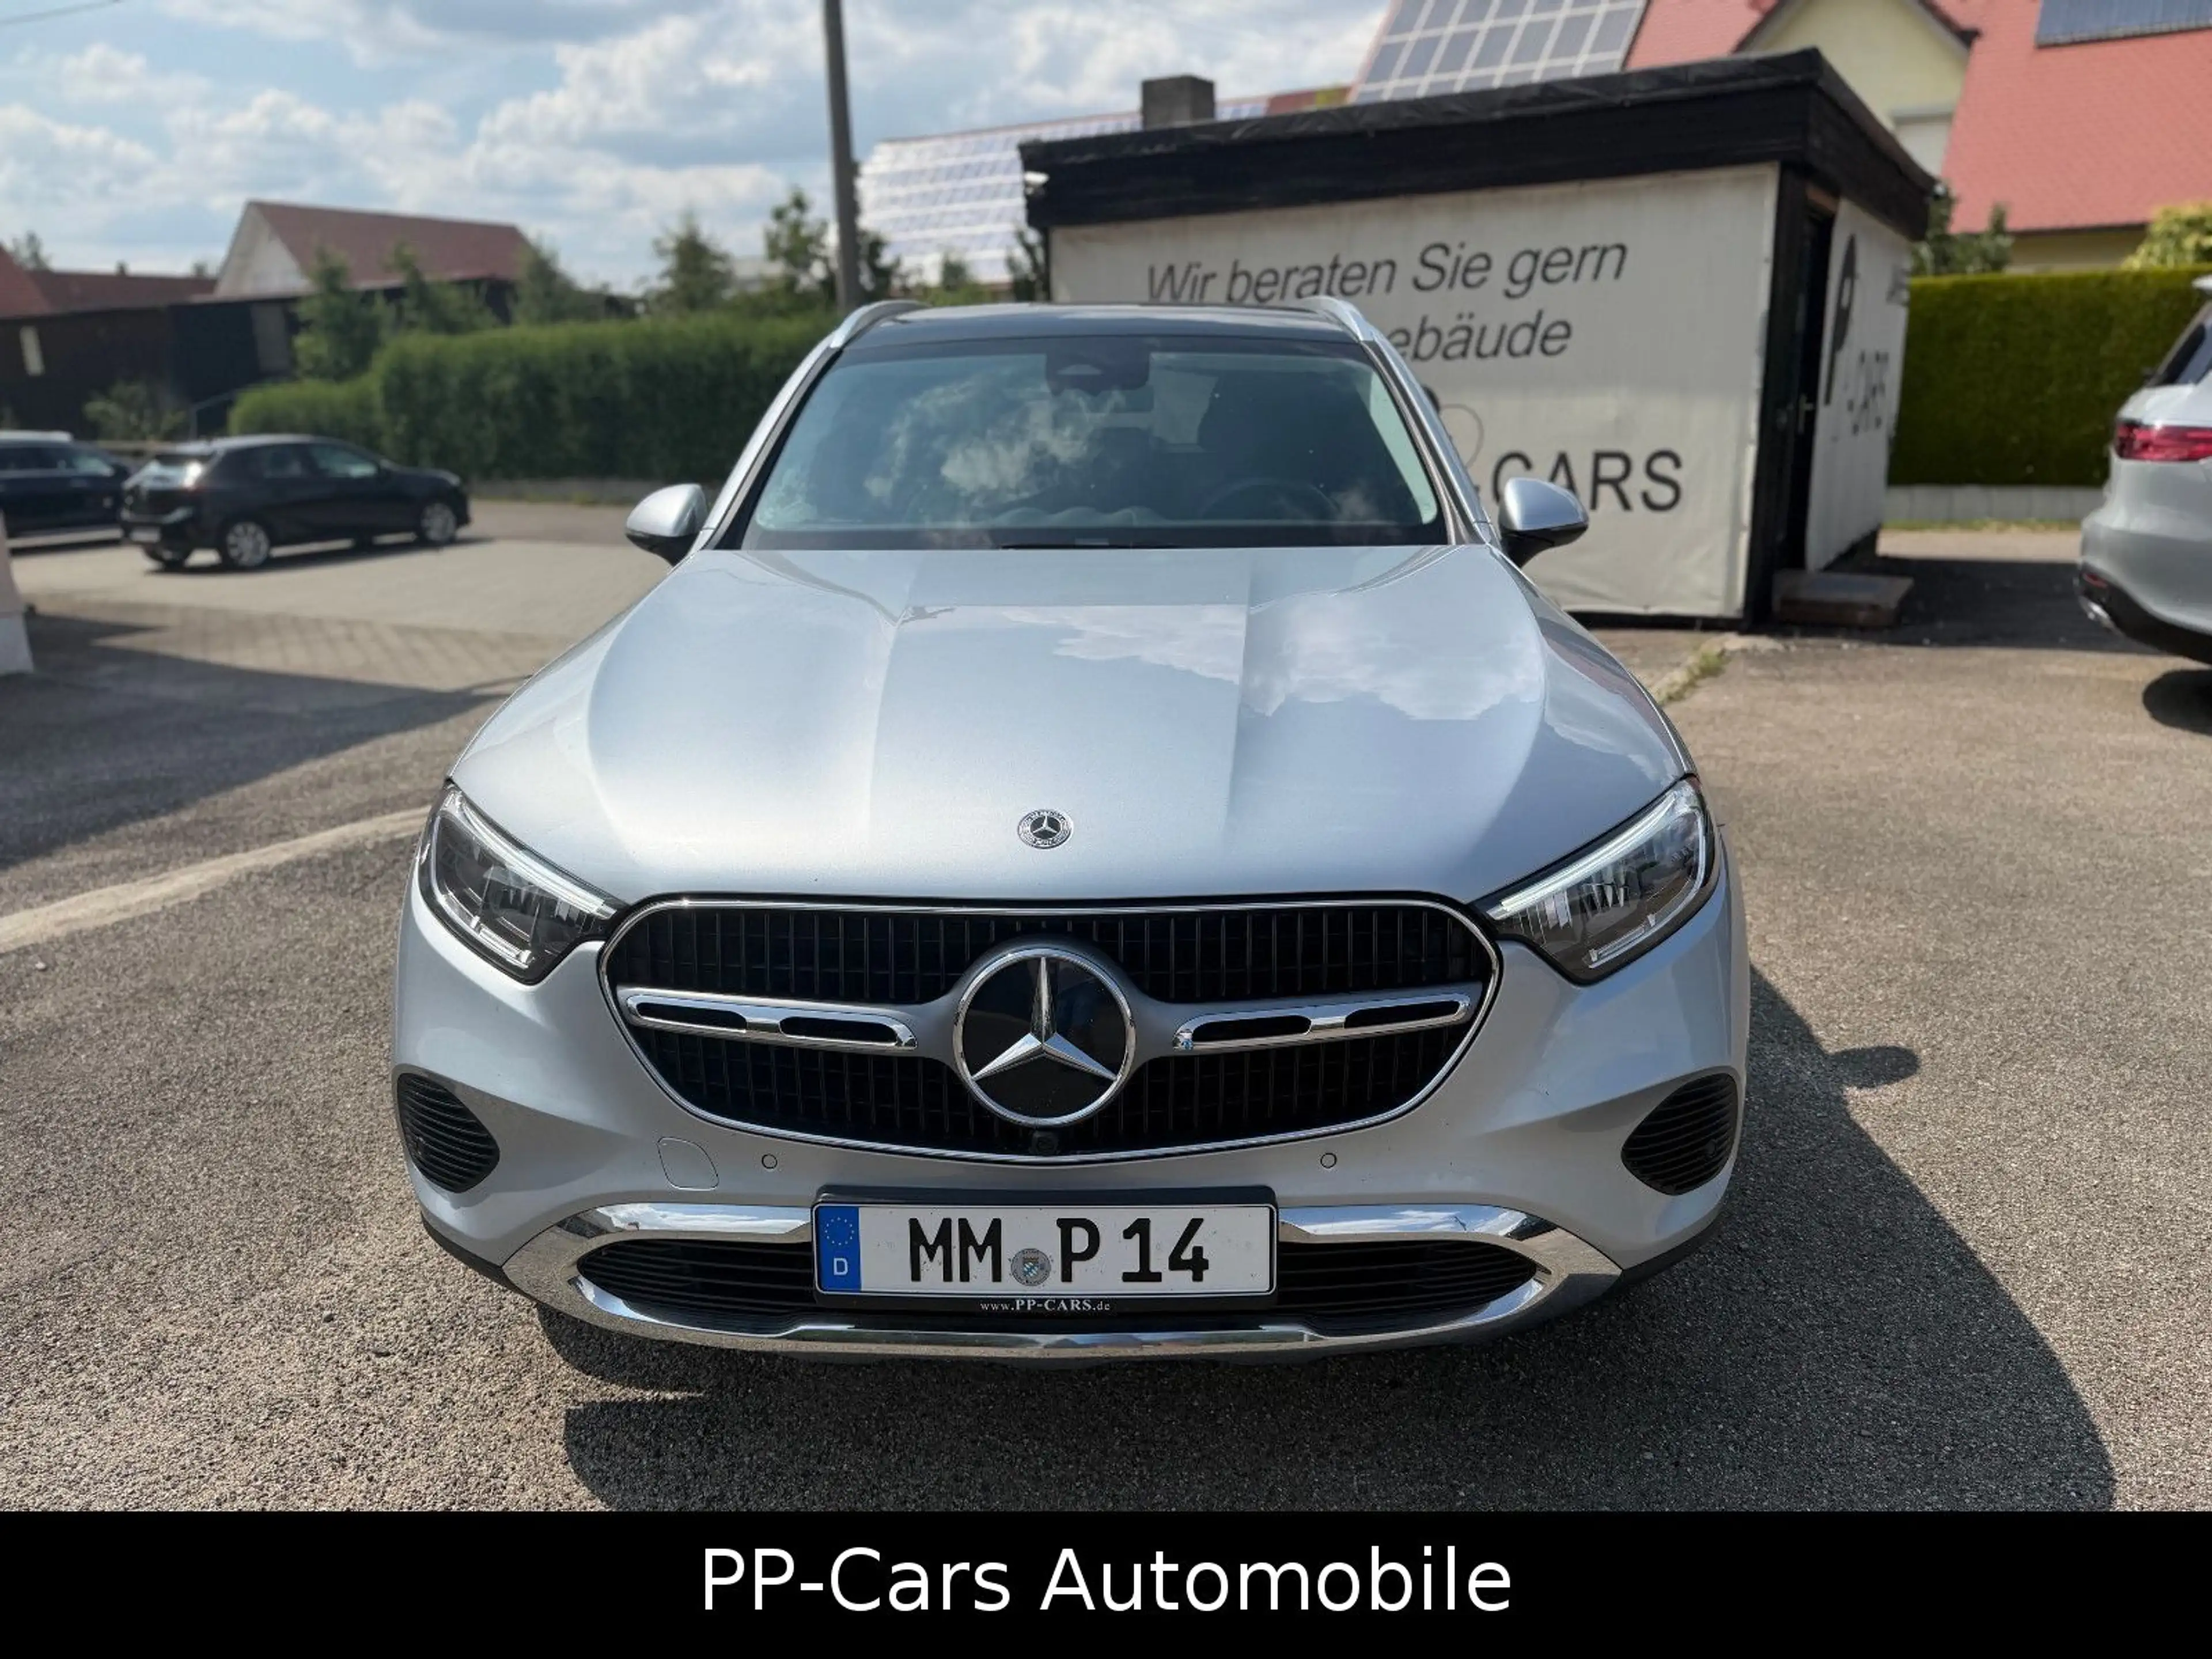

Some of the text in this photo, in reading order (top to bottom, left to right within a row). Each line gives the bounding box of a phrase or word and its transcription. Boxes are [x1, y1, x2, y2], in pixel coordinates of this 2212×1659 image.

[1147, 229, 1627, 304] Wir beraten Sie gern
[1387, 309, 1572, 362] ebäude
[834, 1257, 849, 1276] D
[909, 1218, 1002, 1283] MM
[1056, 1218, 1101, 1283] P
[1122, 1218, 1209, 1283] 14
[980, 1299, 1111, 1311] www.PP-CARS.de
